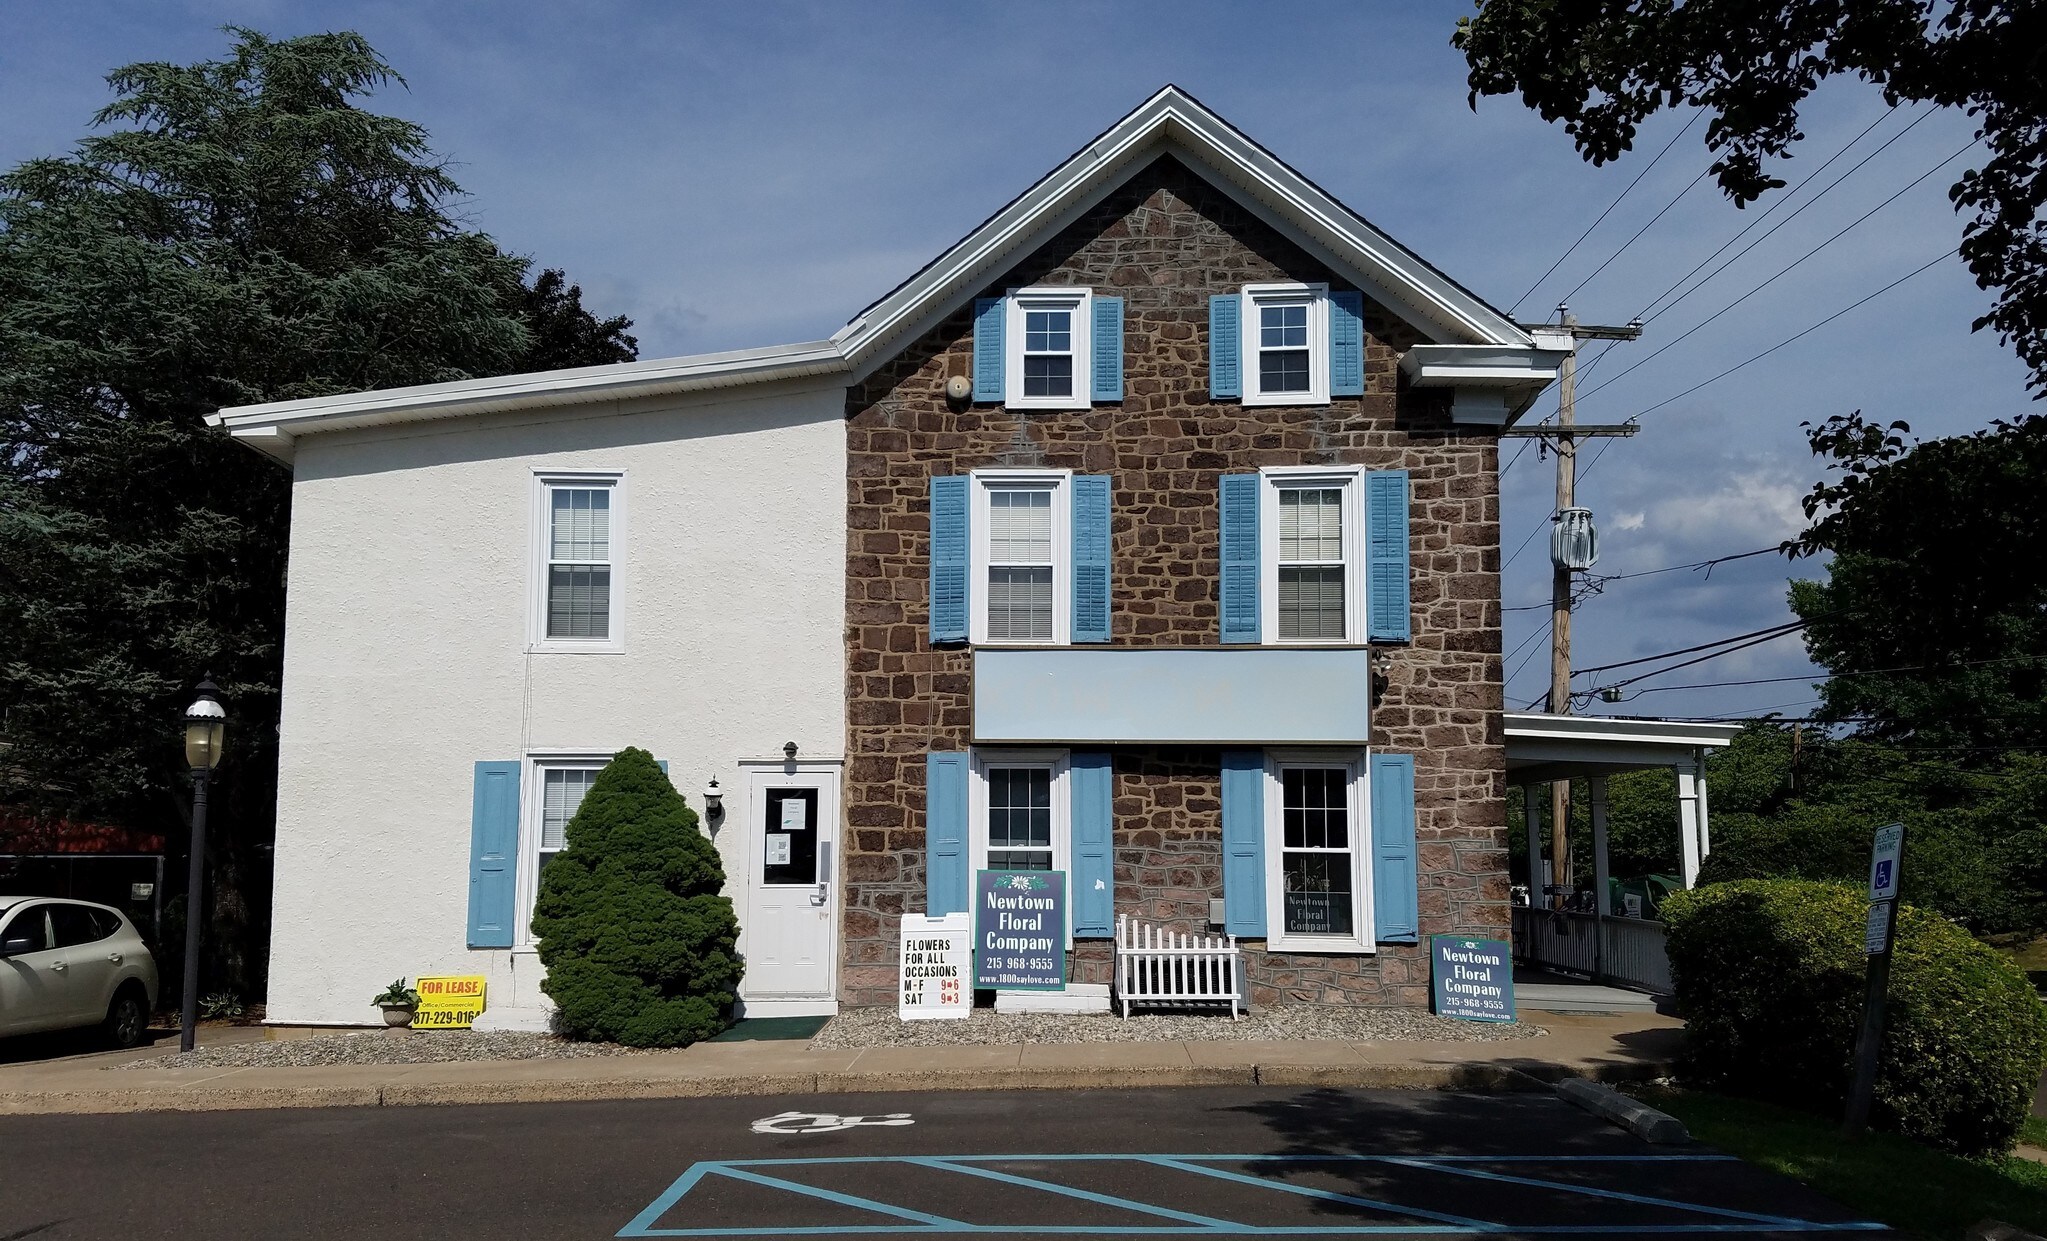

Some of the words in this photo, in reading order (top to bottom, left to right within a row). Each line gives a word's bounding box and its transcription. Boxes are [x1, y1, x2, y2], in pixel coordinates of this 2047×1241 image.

[987, 891, 1054, 910] Newtown
[1289, 896, 1330, 906] Newtown
[1297, 908, 1324, 919] Floral
[999, 912, 1042, 930] Floral
[1290, 919, 1331, 933] Company
[906, 939, 951, 951] FLOWERS
[986, 931, 1054, 953] Company
[905, 953, 923, 964] FOR
[927, 953, 945, 964] ALL
[1442, 947, 1500, 965] Newtown
[986, 957, 1002, 969] 215
[905, 966, 957, 978] OCCASIONS
[1454, 965, 1491, 981] Floral
[979, 973, 1060, 984] www.1800saylove.com
[421, 982, 444, 994] FOR
[445, 981, 478, 994] LEASE
[1445, 978, 1501, 999] Company
[904, 993, 923, 1005] SAT
[1441, 1008, 1510, 1019] www.1800saylove.com
